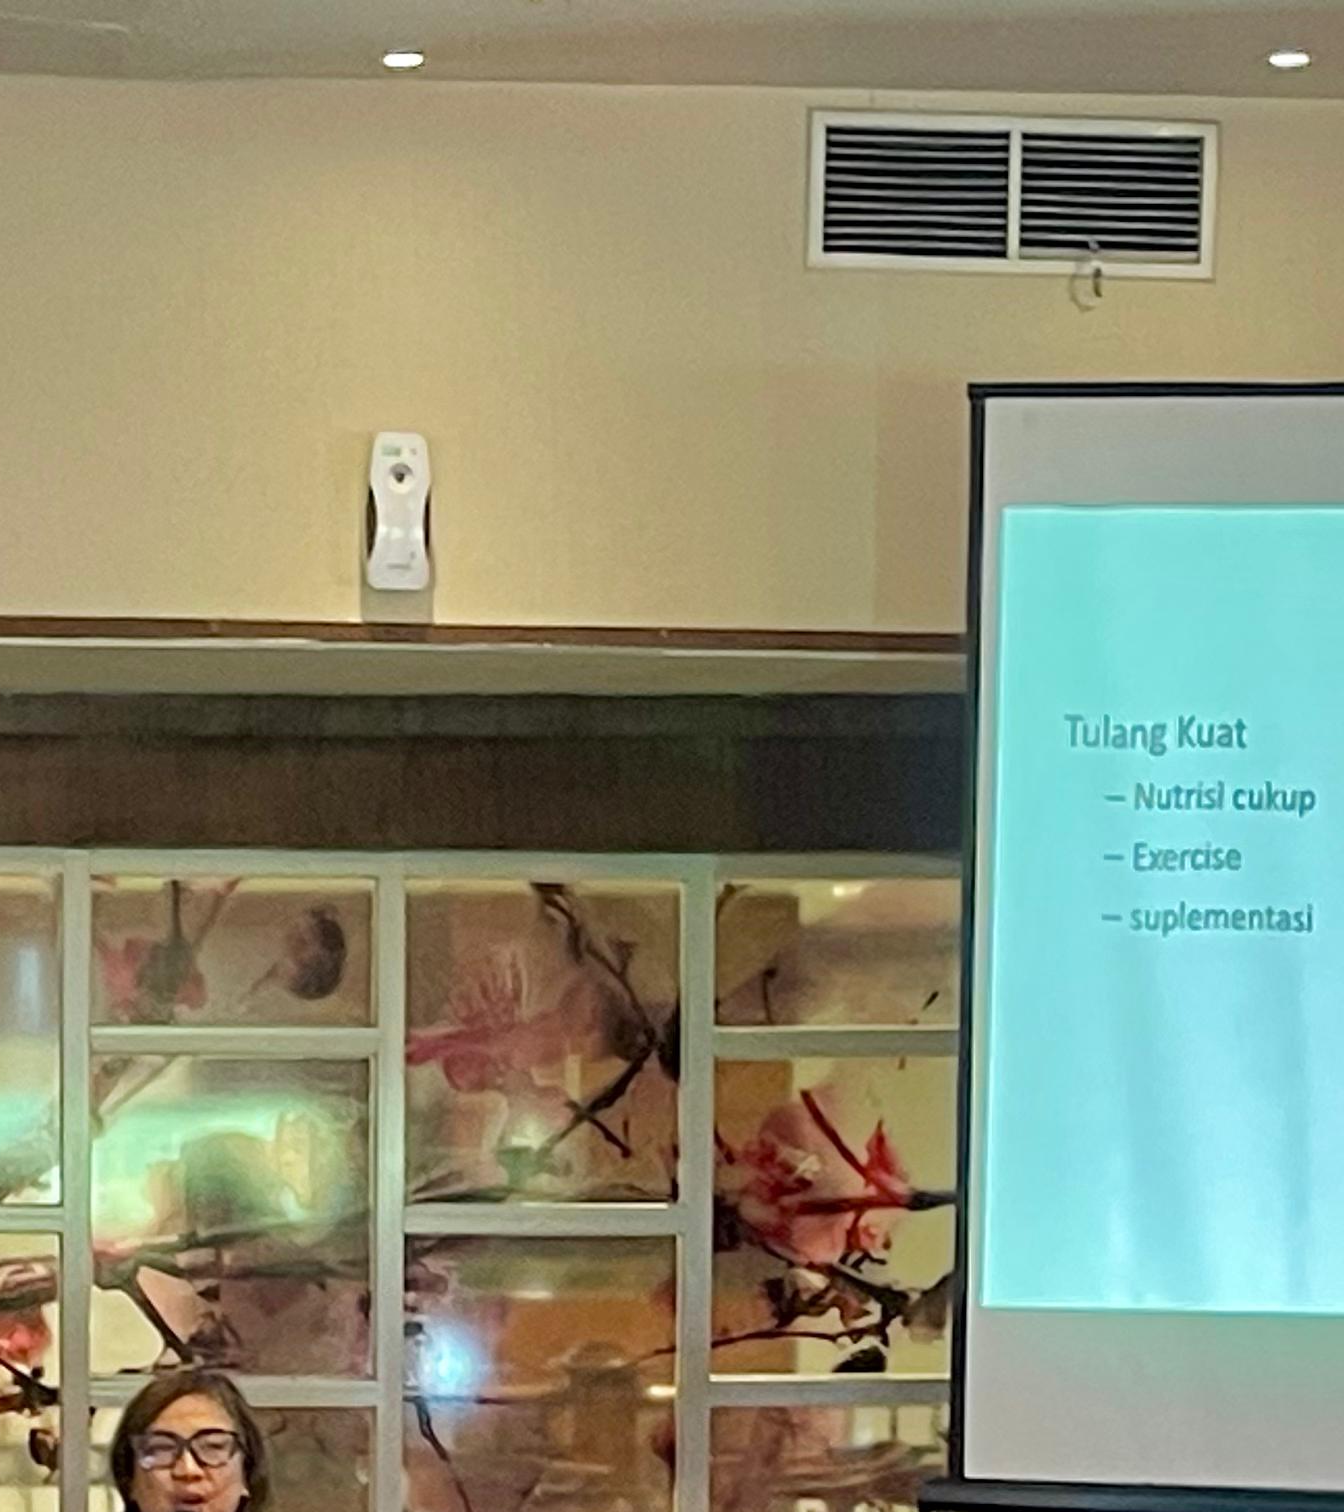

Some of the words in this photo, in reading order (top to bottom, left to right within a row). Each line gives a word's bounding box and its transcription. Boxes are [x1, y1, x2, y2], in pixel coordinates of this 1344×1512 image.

[1064, 713, 1167, 757] Tulang
[1178, 714, 1248, 750] Kuat
[1133, 780, 1225, 811] Nutrisi
[1232, 780, 1317, 818] cukup
[1132, 842, 1242, 872] Exercise
[1129, 900, 1314, 938] suplementasi
